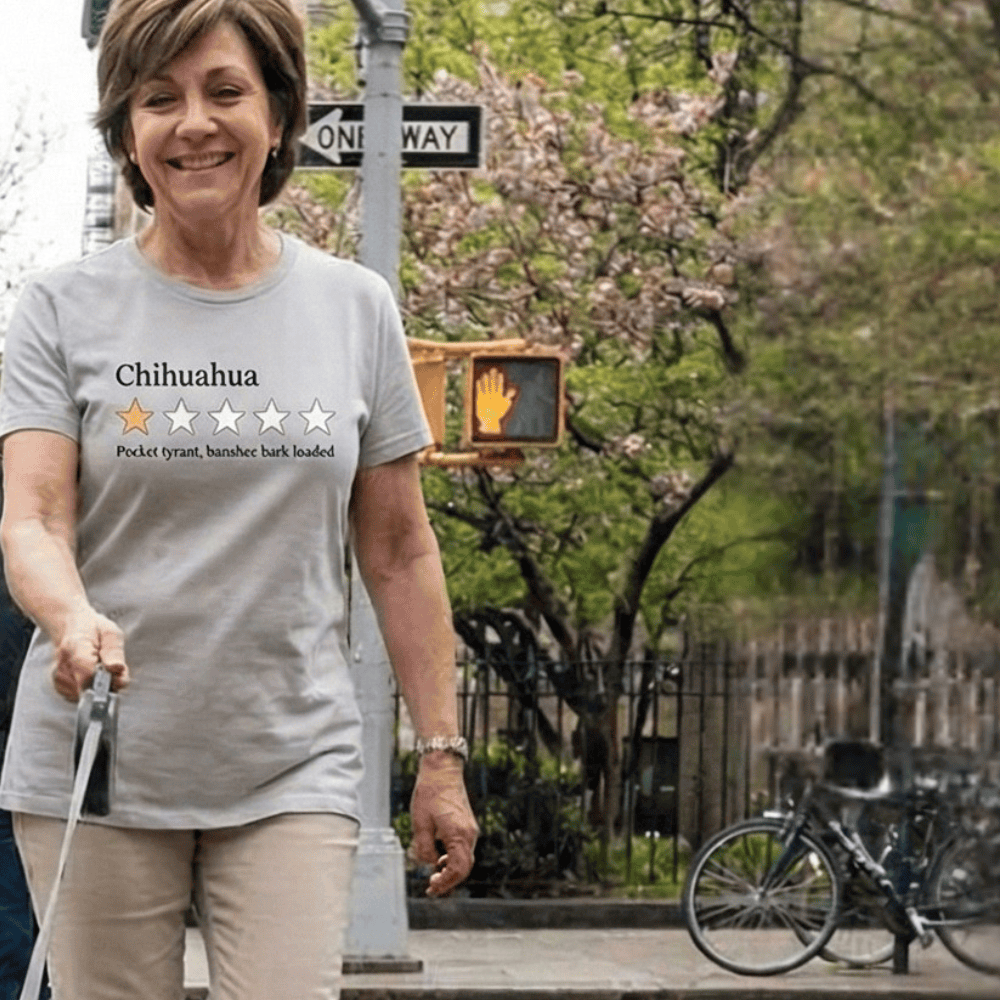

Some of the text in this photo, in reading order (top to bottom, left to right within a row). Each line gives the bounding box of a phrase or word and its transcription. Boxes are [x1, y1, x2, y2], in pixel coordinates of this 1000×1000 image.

[401, 125, 458, 150] WAY
[115, 361, 260, 387] Chihuahua
[161, 446, 204, 461] tyrant,
[260, 444, 290, 458] bark
[292, 444, 335, 458] loaded
